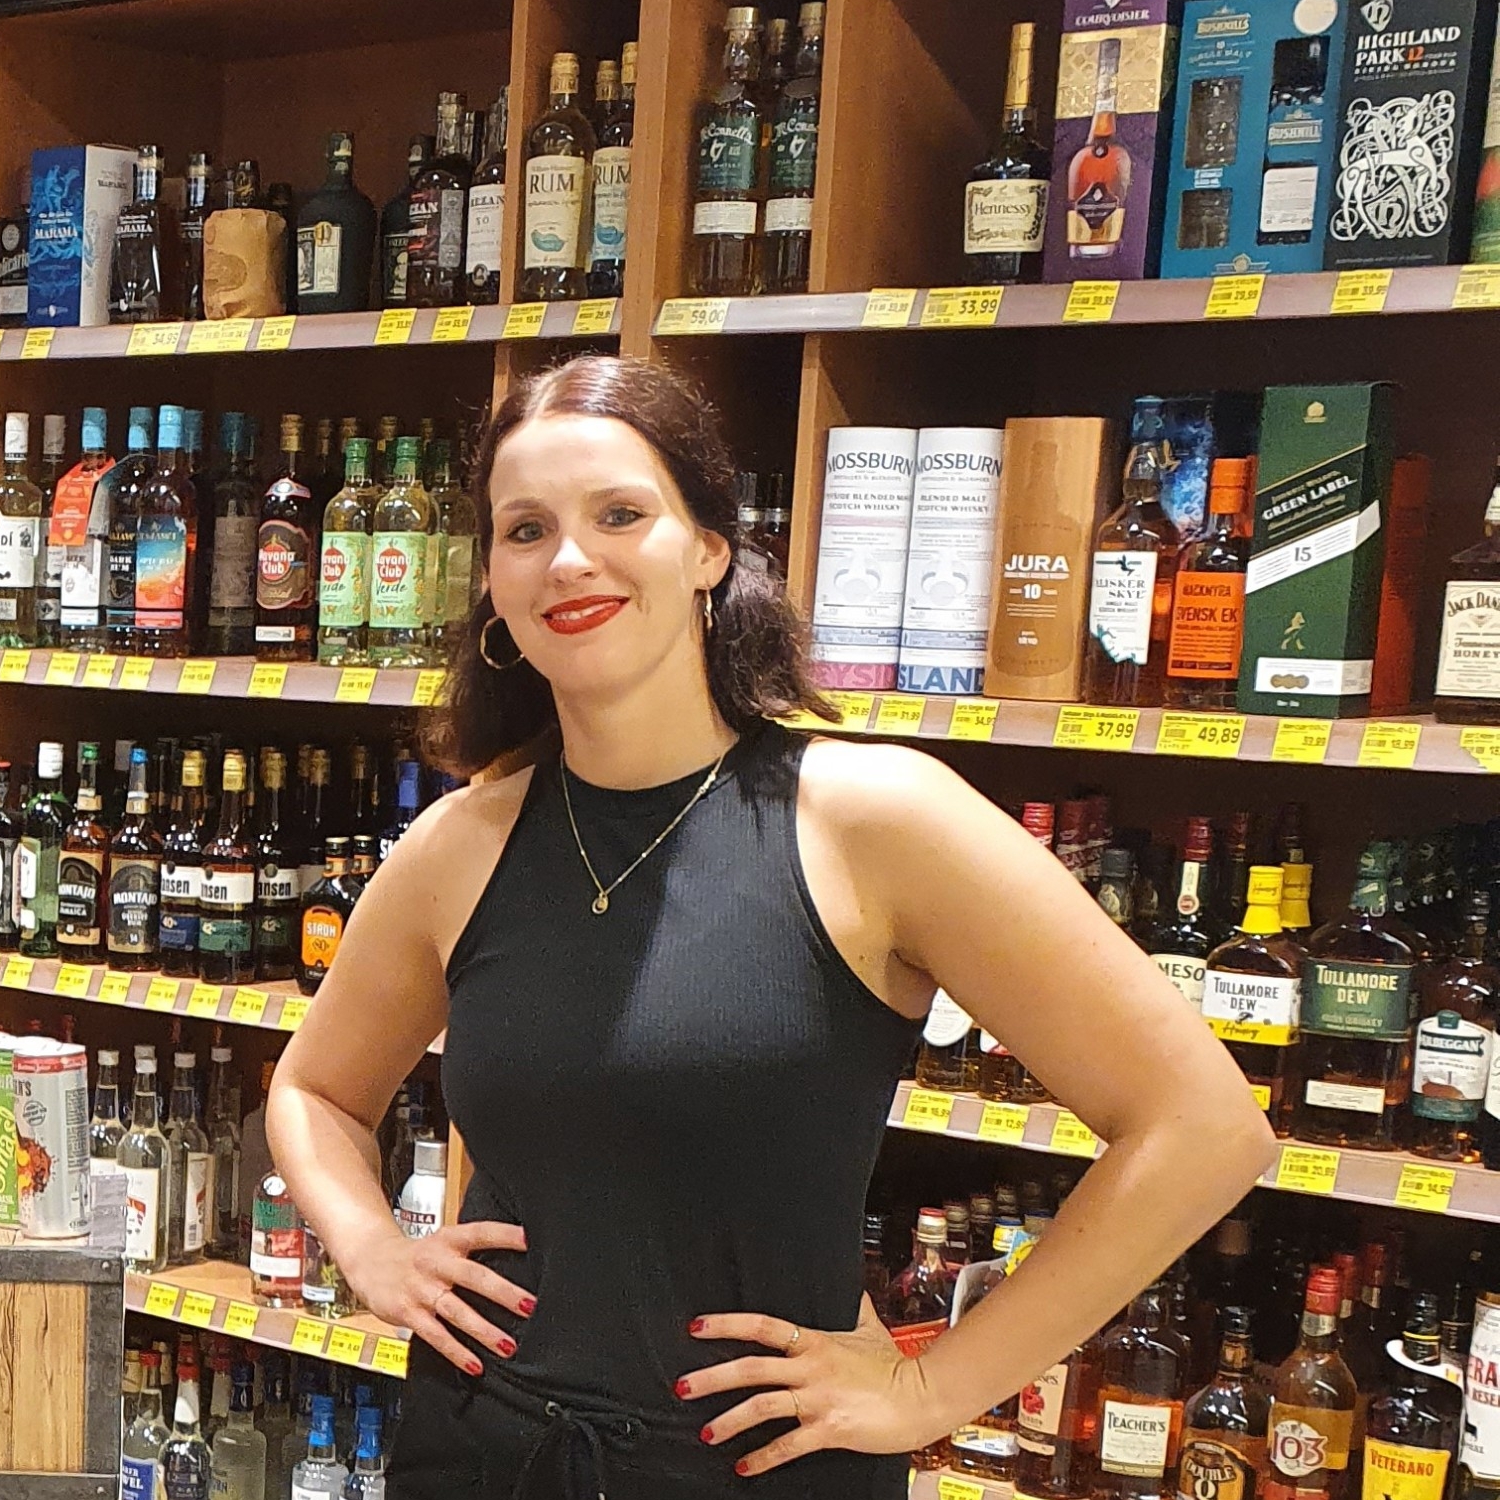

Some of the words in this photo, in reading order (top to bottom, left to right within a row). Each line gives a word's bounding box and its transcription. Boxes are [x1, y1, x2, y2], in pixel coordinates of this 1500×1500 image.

[1357, 26, 1461, 50] HIGHLAND
[1355, 48, 1406, 66] PARK
[1407, 46, 1425, 62] 12
[1268, 126, 1322, 141] BUSHMILL
[529, 173, 576, 194] RUM
[593, 164, 631, 184] RUM
[974, 200, 1032, 217] Hennessy
[959, 298, 998, 316] 33,99
[827, 451, 914, 478] MOSSBURN
[915, 453, 1003, 478] MOSSBURN
[1262, 494, 1308, 521] GREEN
[1311, 476, 1358, 502] LABEL
[1004, 554, 1070, 572] JURA
[1294, 546, 1313, 563] 15
[1024, 584, 1042, 599] 10
[1220, 607, 1239, 623] EK
[1095, 722, 1135, 740] 37,99
[1197, 726, 1241, 745] 49,89
[1158, 961, 1205, 982] MESO
[1316, 964, 1399, 992] TULLAMORE
[1214, 976, 1280, 1000] TULLAMORE
[1336, 987, 1371, 1006] DEW
[1230, 996, 1257, 1011] DEW
[1107, 1411, 1167, 1433] TEACHER'S
[1270, 1431, 1327, 1469] 103
[1369, 1449, 1435, 1478] VETERANO
